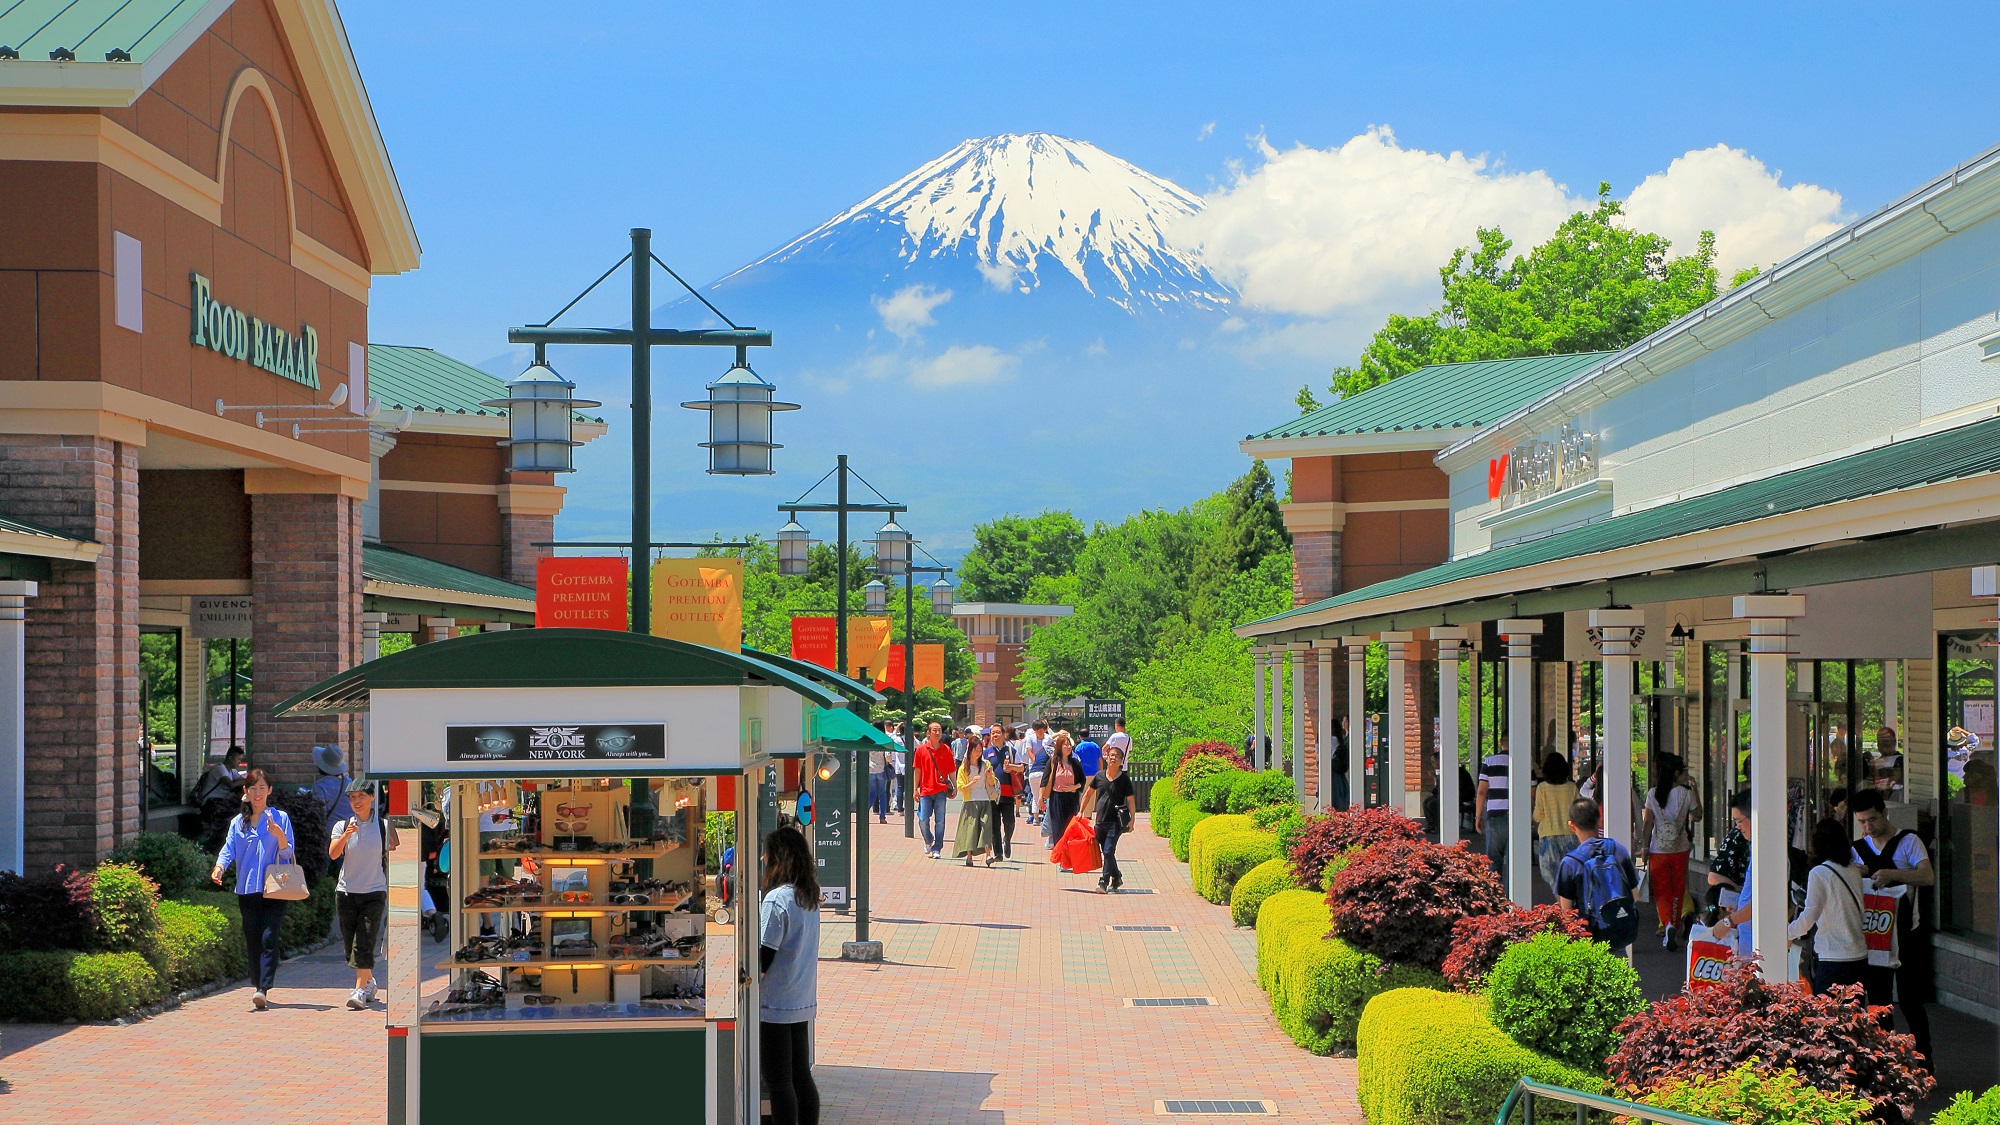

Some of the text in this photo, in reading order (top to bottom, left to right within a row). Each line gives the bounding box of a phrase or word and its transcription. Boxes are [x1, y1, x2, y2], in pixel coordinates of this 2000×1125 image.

[191, 273, 320, 390] FOOD BAZAAR
[551, 573, 613, 586] GOTEMBA
[667, 574, 729, 588] GOTEMBA
[553, 592, 610, 602] PREMIUM
[669, 595, 726, 605] PREMIUM
[200, 600, 253, 608] GIVENCH
[200, 613, 235, 621] EMILIO
[554, 609, 609, 619] OUTLETS
[670, 612, 724, 622] OUTLETS
[529, 749, 585, 758] NEW YORK
[1862, 911, 1890, 932] EGO
